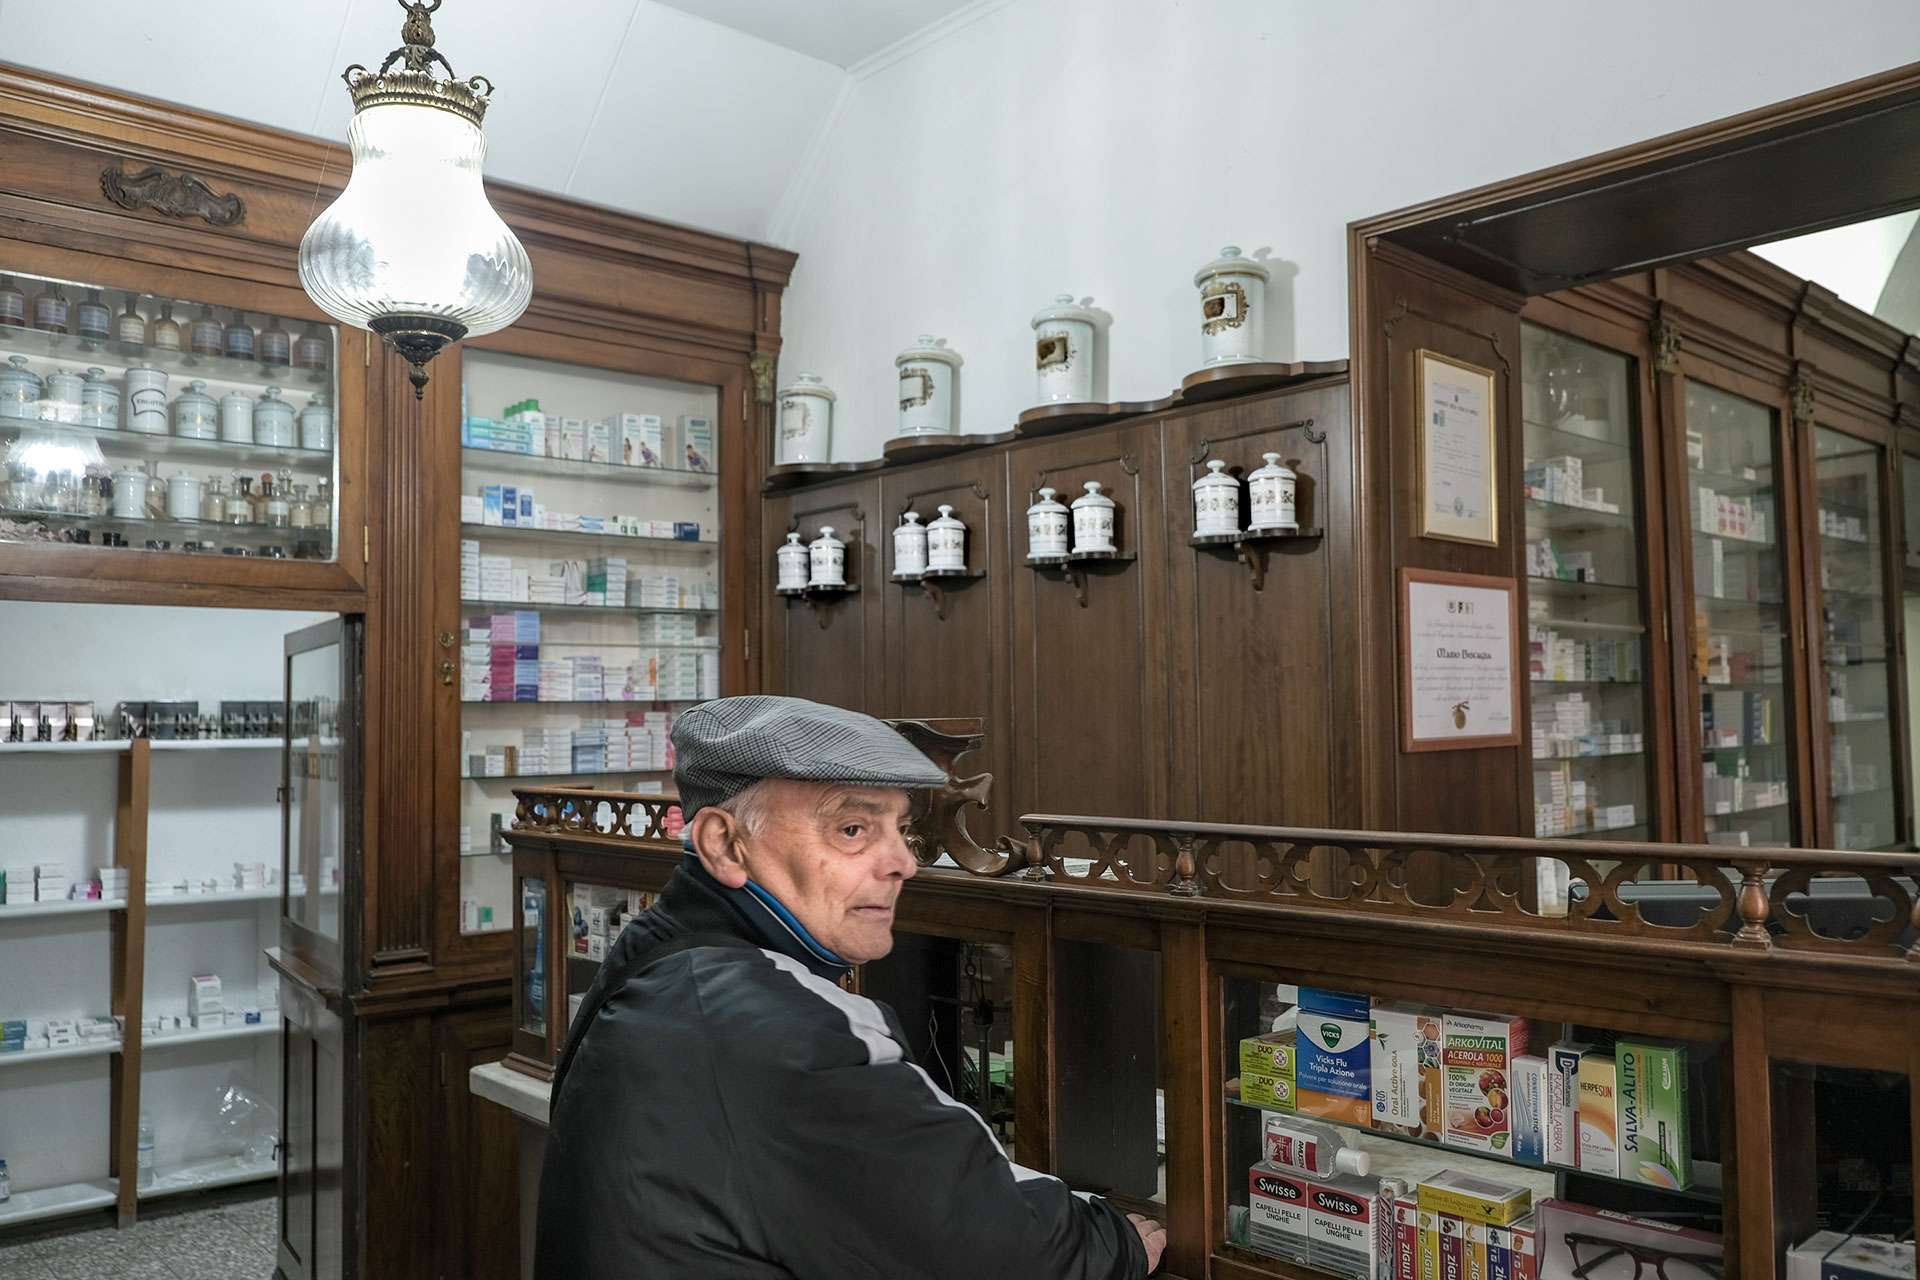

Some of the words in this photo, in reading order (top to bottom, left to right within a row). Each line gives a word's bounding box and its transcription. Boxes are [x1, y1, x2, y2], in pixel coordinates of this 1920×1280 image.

[1321, 1029, 1341, 1040] VICKS
[1447, 1036, 1505, 1050] ARKOVITAL
[1315, 1054, 1335, 1066] Vicks
[1335, 1058, 1348, 1068] Flu
[1447, 1049, 1484, 1061] ACEROLA
[1486, 1053, 1504, 1063] 1000
[1309, 1062, 1329, 1075] Tripla
[1329, 1066, 1355, 1079] Azione
[1448, 1073, 1467, 1082] 100%
[1554, 1073, 1562, 1112] RAGADI
[1580, 1082, 1612, 1098] HERPESUN
[1391, 1100, 1399, 1116] Oral
[1623, 1052, 1638, 1153] SALVA-ALITO
[1554, 1113, 1562, 1152] LABBRA
[1259, 1177, 1297, 1200] Swisse
[1255, 1202, 1281, 1215] CAPELLI
[1281, 1208, 1301, 1221] PELLE
[1318, 1192, 1358, 1215] Swisse
[1266, 1213, 1290, 1225] UNGHIE
[1314, 1217, 1341, 1231] CAPELLI
[1342, 1225, 1363, 1237] PELLE
[1325, 1228, 1351, 1241] UNGHIE
